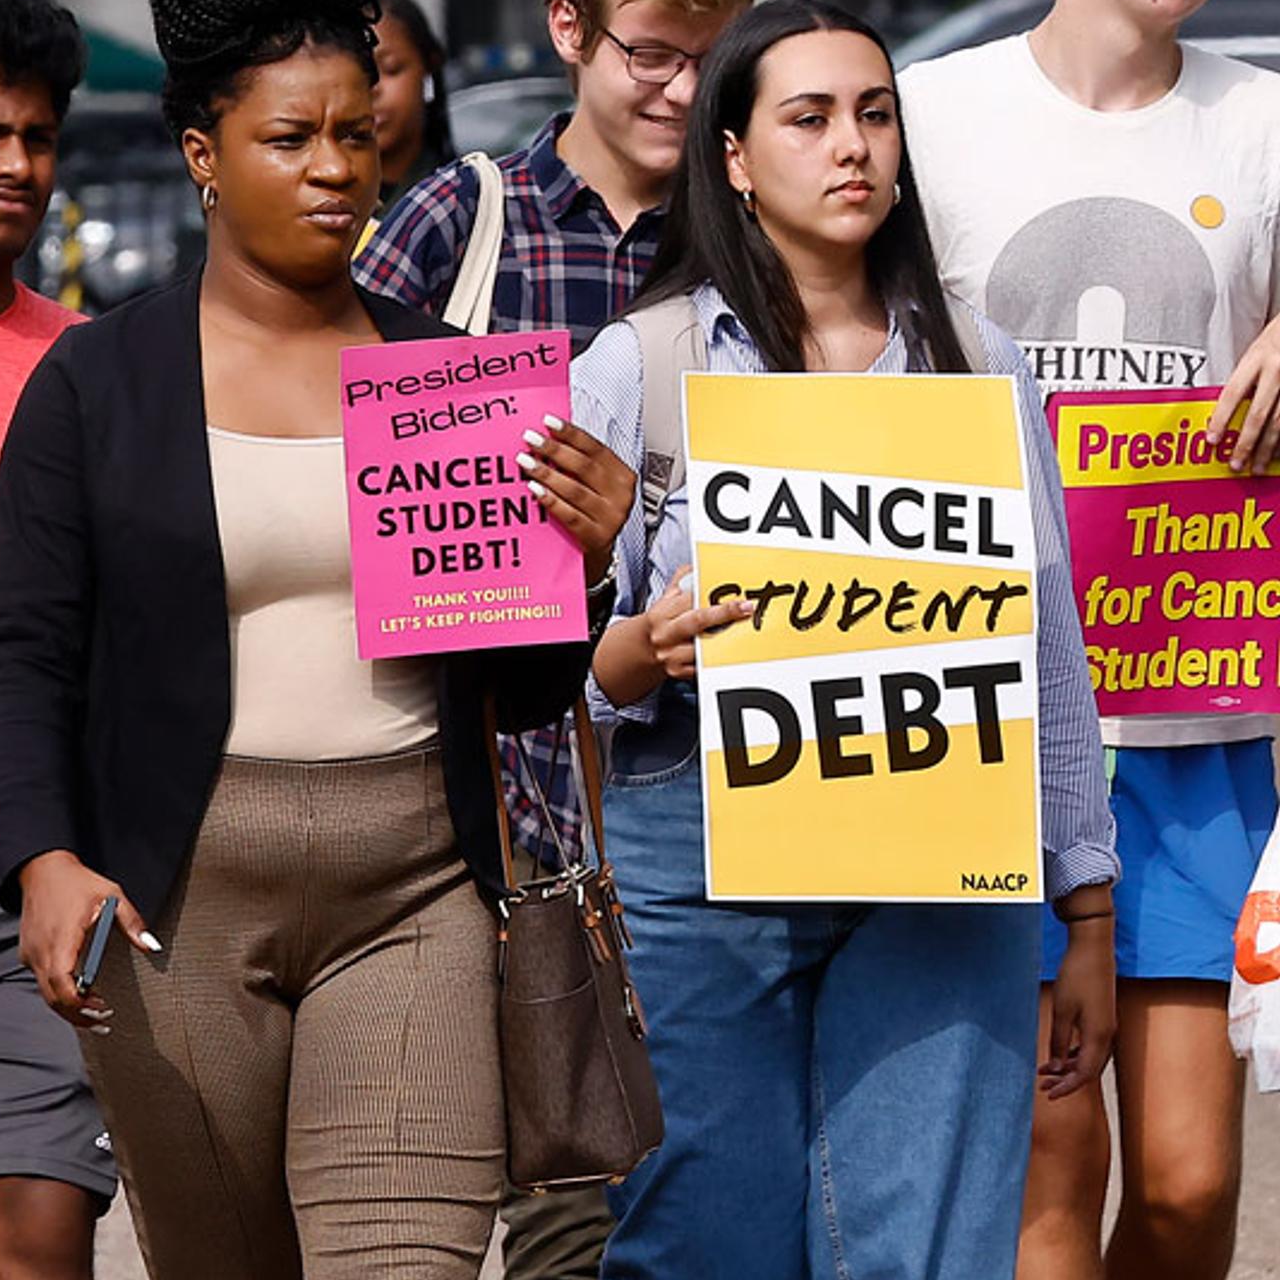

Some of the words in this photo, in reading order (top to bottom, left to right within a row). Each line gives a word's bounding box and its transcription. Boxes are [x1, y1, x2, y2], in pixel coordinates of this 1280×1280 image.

[345, 343, 558, 408] President
[1024, 346, 1208, 386] HITNEY
[391, 396, 518, 440] Biden:
[1077, 417, 1240, 472] Preside
[357, 455, 528, 495] CANCEL
[703, 470, 1014, 558] CANCEL
[1126, 496, 1274, 557] Thank
[412, 538, 522, 576] DEBT!
[412, 591, 468, 609] THANK
[1083, 575, 1153, 627] for
[1160, 570, 1280, 620] Canc
[381, 616, 422, 633] LET'S
[426, 612, 465, 628] KEEP
[716, 661, 1023, 789] DEBT
[961, 872, 1028, 892] NAACP
